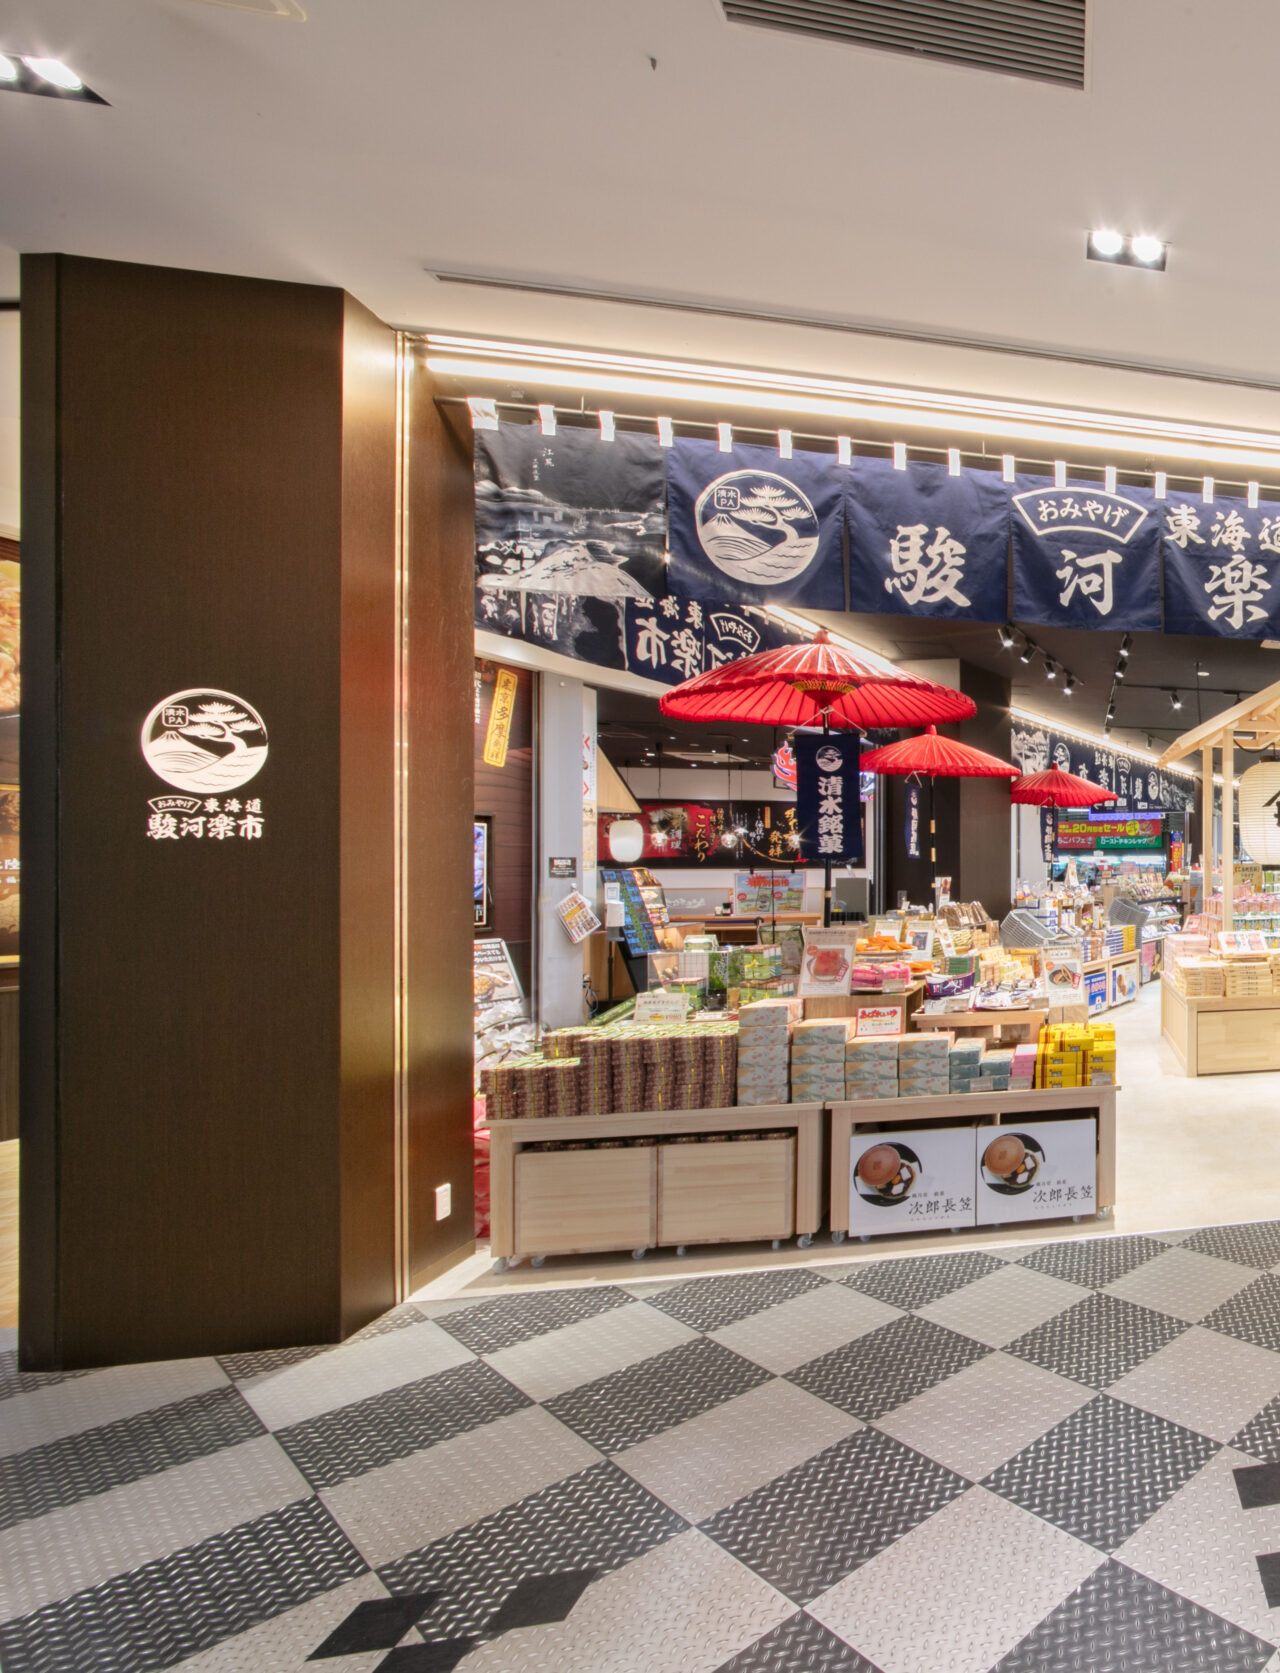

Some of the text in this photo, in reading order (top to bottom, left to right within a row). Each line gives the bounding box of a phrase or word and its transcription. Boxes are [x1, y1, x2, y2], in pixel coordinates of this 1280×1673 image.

[720, 498, 735, 507] PA
[1037, 496, 1130, 530] おみやげ
[168, 717, 183, 725] PA
[157, 800, 194, 809] おみやげ
[203, 798, 263, 814] 東海道
[817, 775, 844, 854] 清水銘菓
[146, 813, 265, 841] 駿河楽市
[1033, 1184, 1095, 1203] 次郎長笠
[908, 1197, 973, 1215] 次郎長笠
